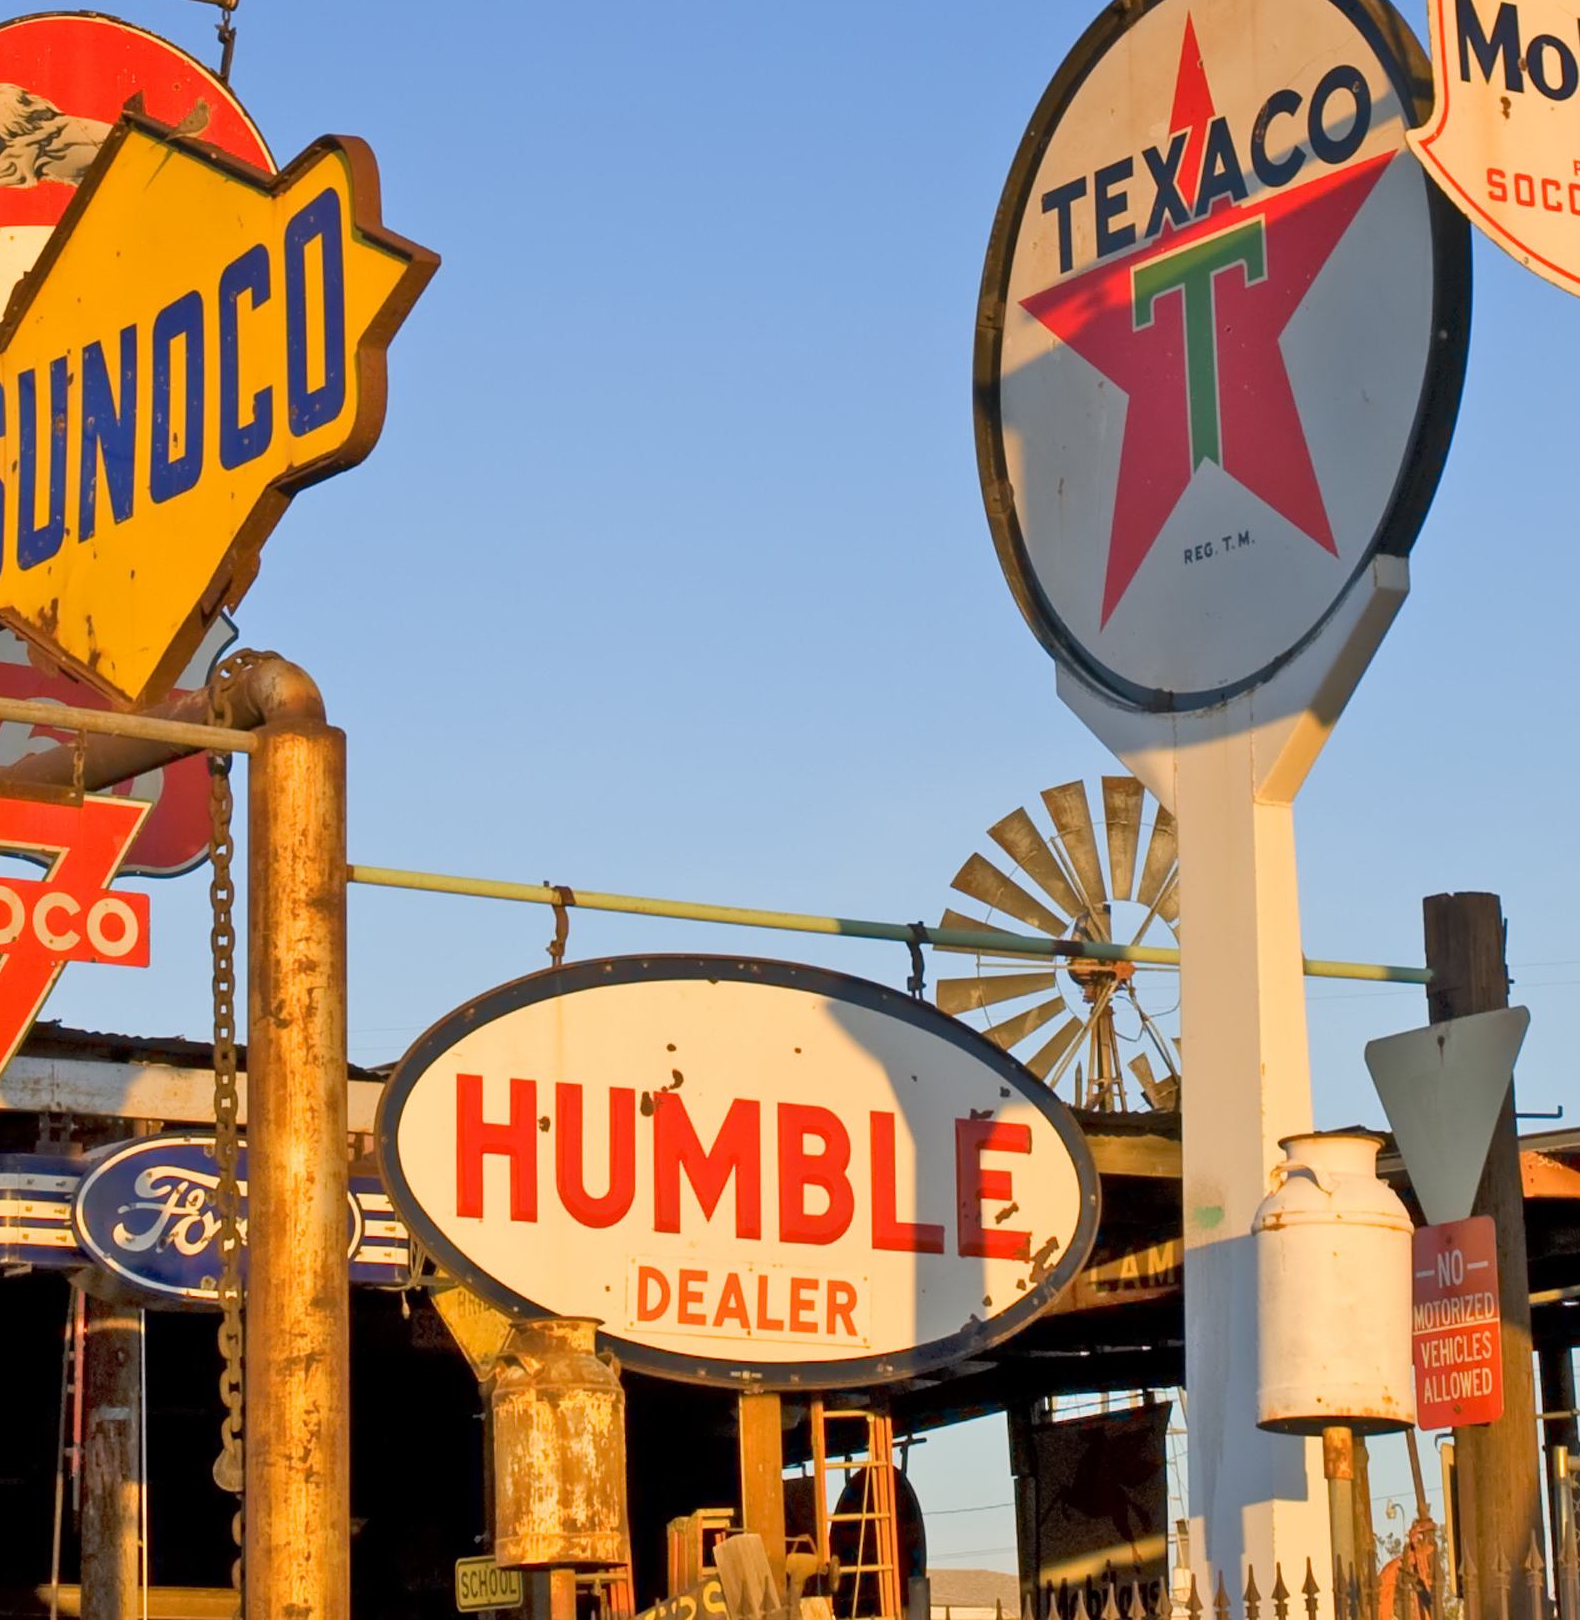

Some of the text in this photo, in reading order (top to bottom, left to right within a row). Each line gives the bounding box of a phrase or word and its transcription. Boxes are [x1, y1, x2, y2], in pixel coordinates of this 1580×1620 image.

[1040, 65, 1371, 274] TEXACO
[1184, 542, 1218, 564] REG.
[456, 1073, 1032, 1261] HUMBLE
[1437, 1249, 1463, 1288] NO
[636, 1265, 859, 1338] DEALER
[1414, 1292, 1494, 1331] MOTORIZED
[1421, 1331, 1492, 1369] VEHICLES
[1424, 1367, 1492, 1404] ALLOWED
[461, 1570, 518, 1598] SCHOOL
